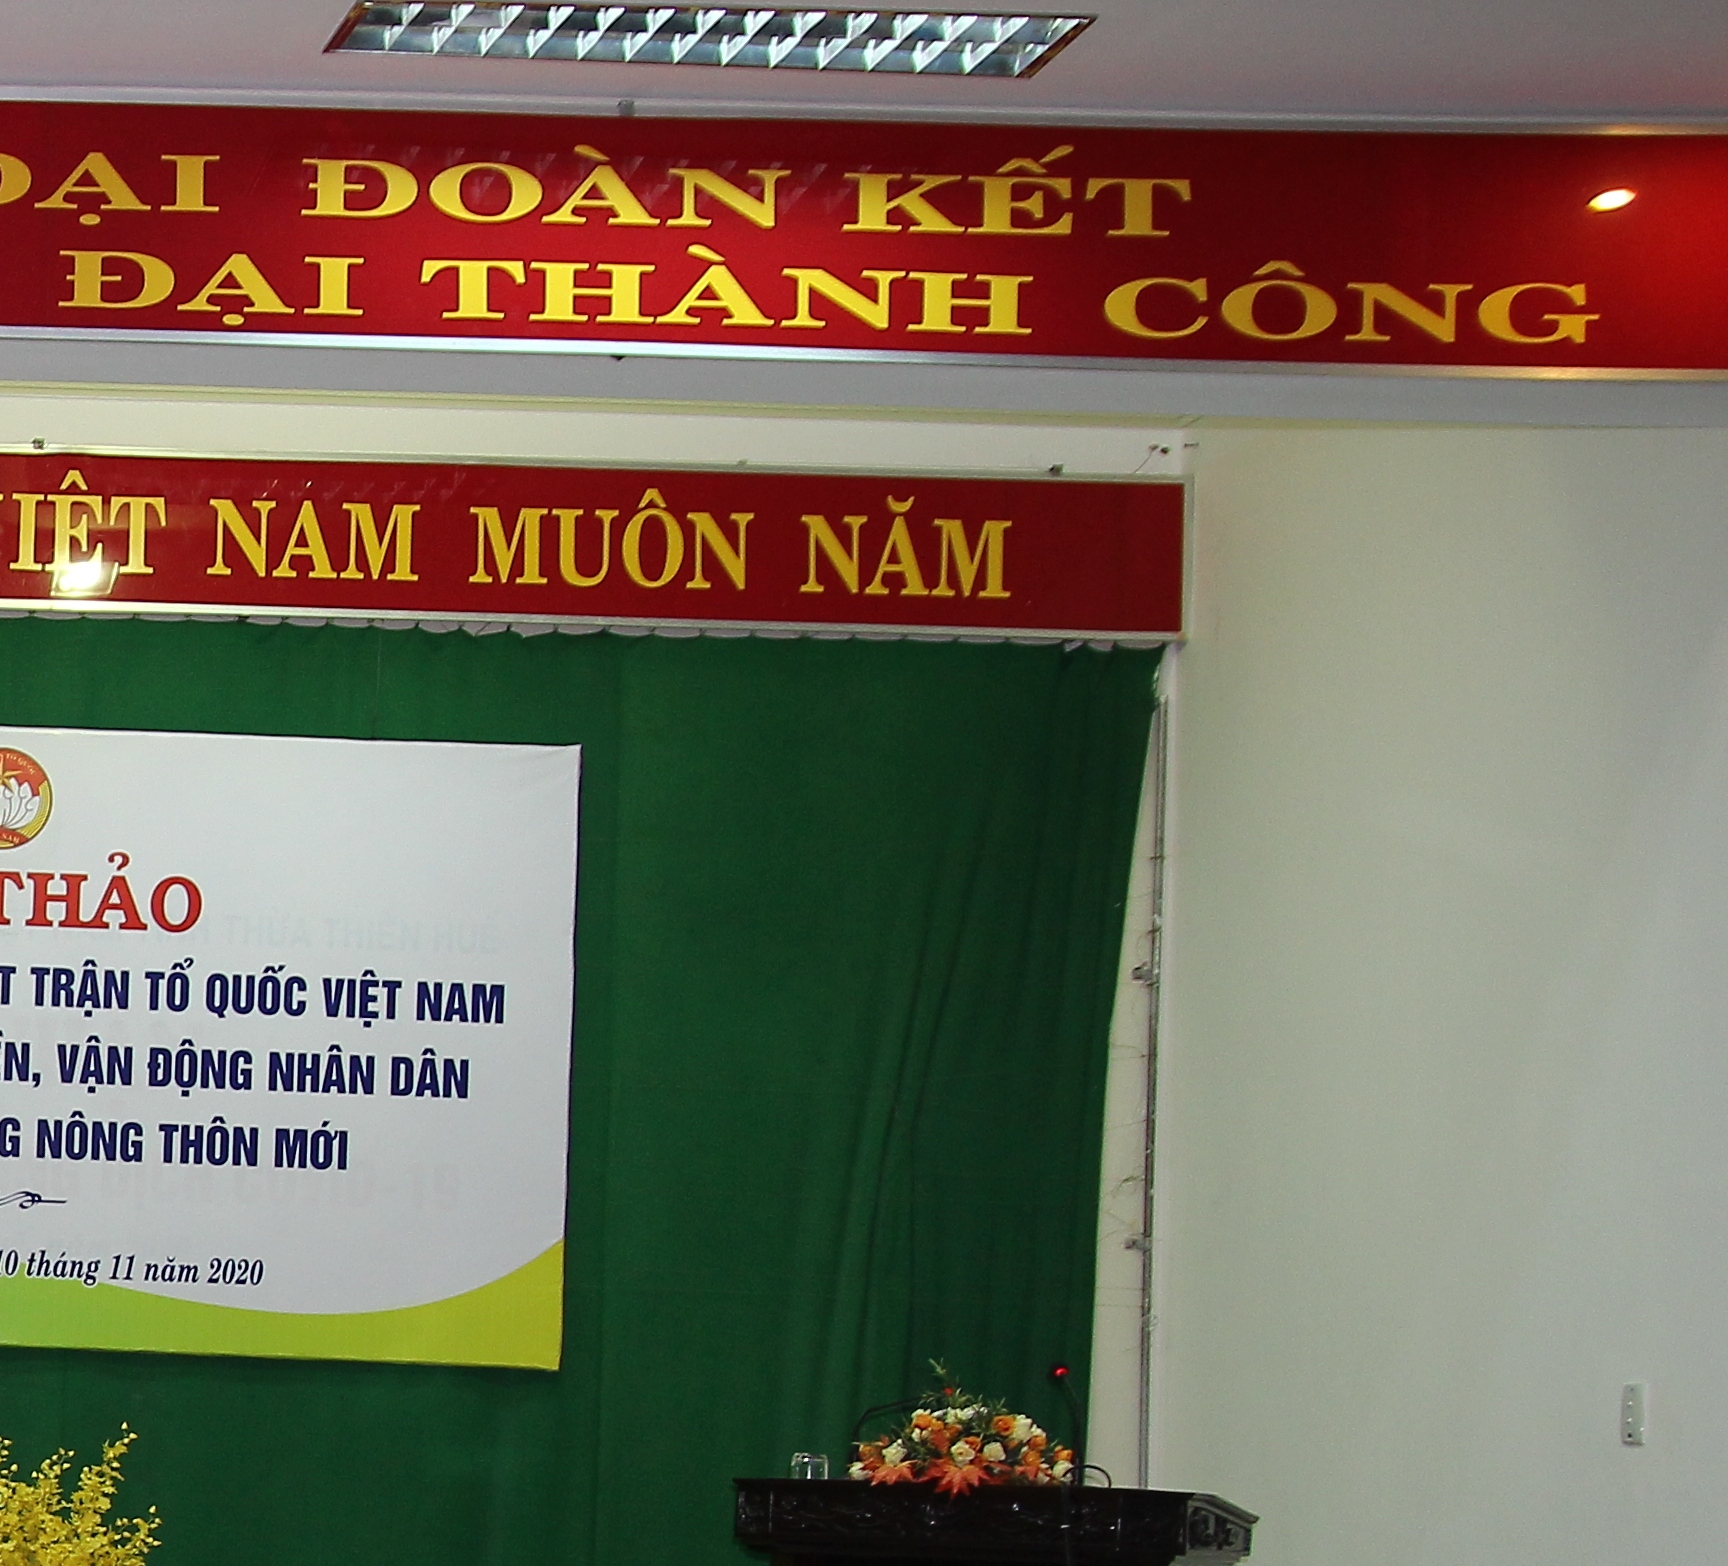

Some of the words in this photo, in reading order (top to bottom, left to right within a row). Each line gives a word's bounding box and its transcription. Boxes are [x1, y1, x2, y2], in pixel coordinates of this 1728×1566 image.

[301, 146, 778, 228] ĐOÀN
[842, 149, 1189, 235] KẾT
[59, 251, 364, 325] ĐẠI
[421, 245, 1033, 334] THÀNH
[1105, 262, 1599, 342] CÔNG
[207, 499, 420, 581] NAM
[469, 489, 754, 589] MUÔN
[800, 497, 1011, 597] NĂM
[31, 959, 129, 1017] TRẬN
[145, 958, 194, 1012] TỔ
[206, 965, 307, 1018] QUỐC
[323, 970, 402, 1028] VIỆT
[416, 982, 504, 1024] NAM
[57, 1035, 133, 1093] VẬN
[147, 1039, 252, 1097] ĐỘNG
[269, 1044, 375, 1095] NHÂN
[391, 1048, 469, 1098] DÂN
[36, 1111, 143, 1162] NÔNG
[159, 1116, 258, 1166] THÔN
[275, 1121, 348, 1170] MỚI
[27, 1250, 100, 1286] tháng
[109, 1254, 135, 1280] 11
[144, 1257, 199, 1283] năm
[207, 1258, 263, 1285] 2020
